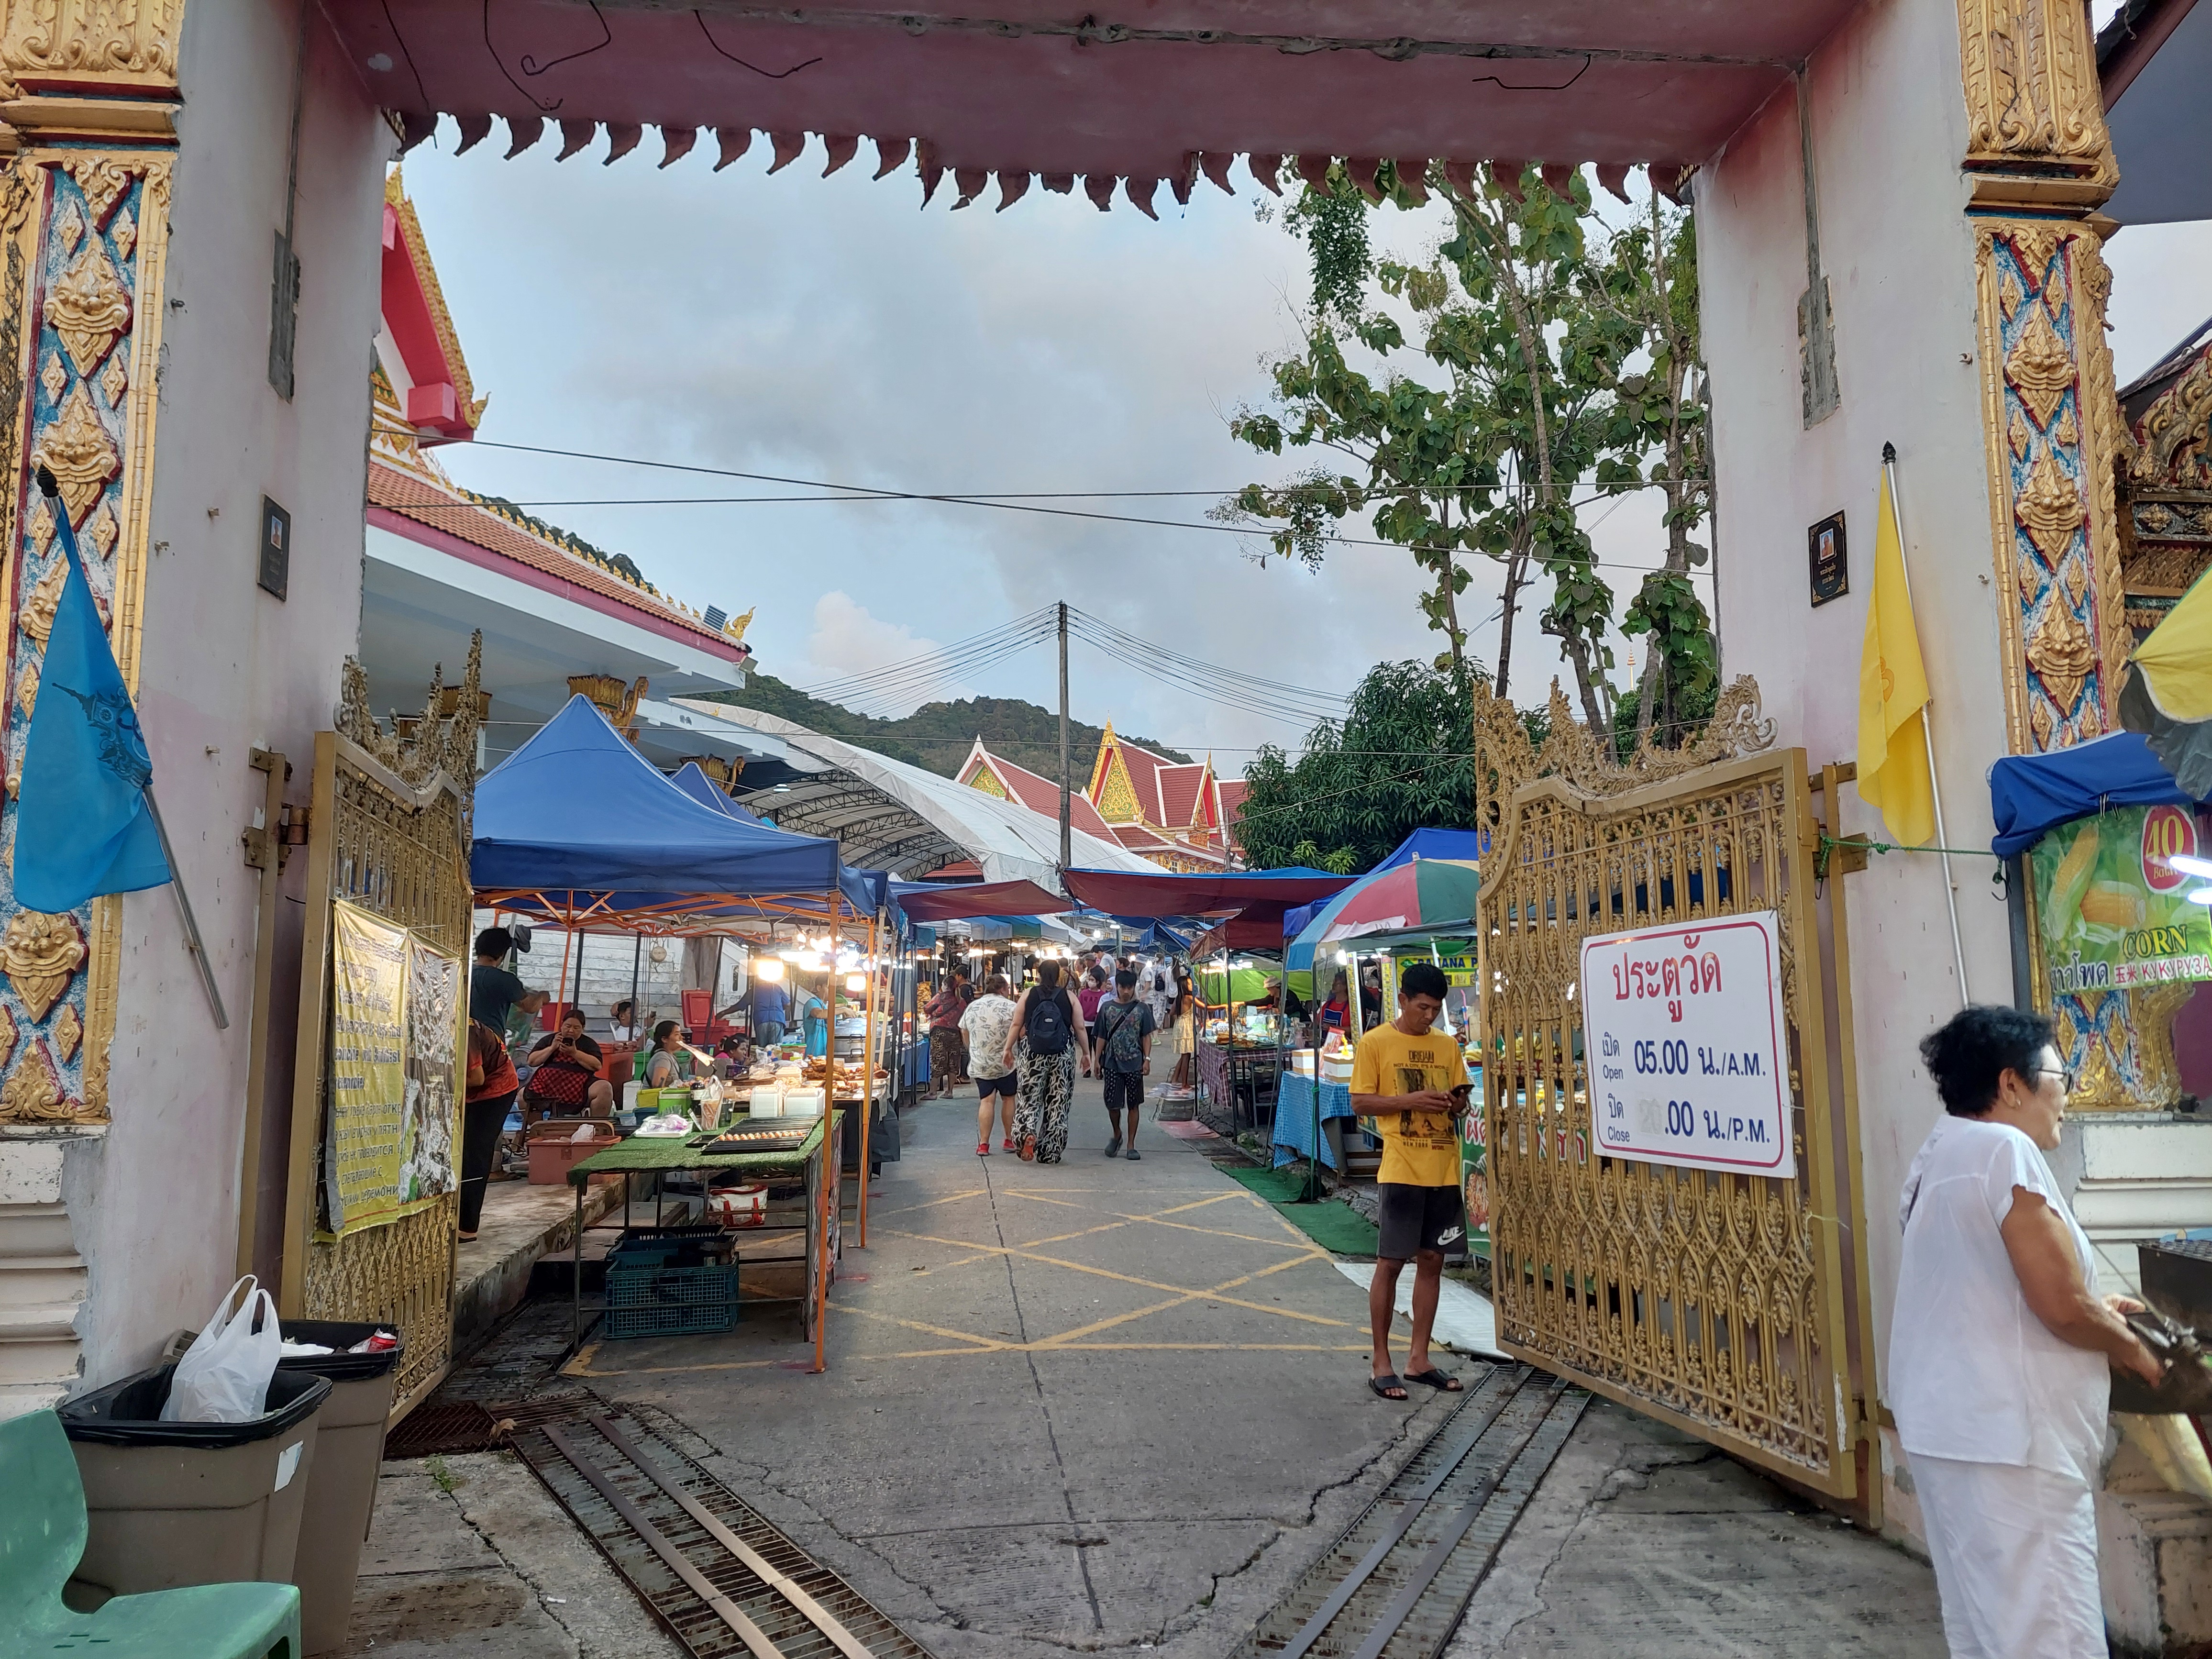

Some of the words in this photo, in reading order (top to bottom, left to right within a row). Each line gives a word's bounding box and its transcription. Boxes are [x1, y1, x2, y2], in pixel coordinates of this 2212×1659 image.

[2146, 815, 2184, 863] 40
[2123, 924, 2188, 959] CORN
[1417, 957, 1465, 968] BAANA
[1613, 935, 1722, 1023] ประตูวัด
[2115, 964, 2138, 984] 玉米
[2142, 956, 2211, 980] КУКУРУЗА
[1602, 1031, 1620, 1058] เปิด
[1635, 1039, 1689, 1074] 05.00
[1698, 1046, 1766, 1076] น./A.M.
[1603, 1064, 1624, 1084] Open
[1608, 1093, 1624, 1119] ปิด
[1703, 1109, 1770, 1143] น./P.M.
[1608, 1126, 1630, 1142] Close
